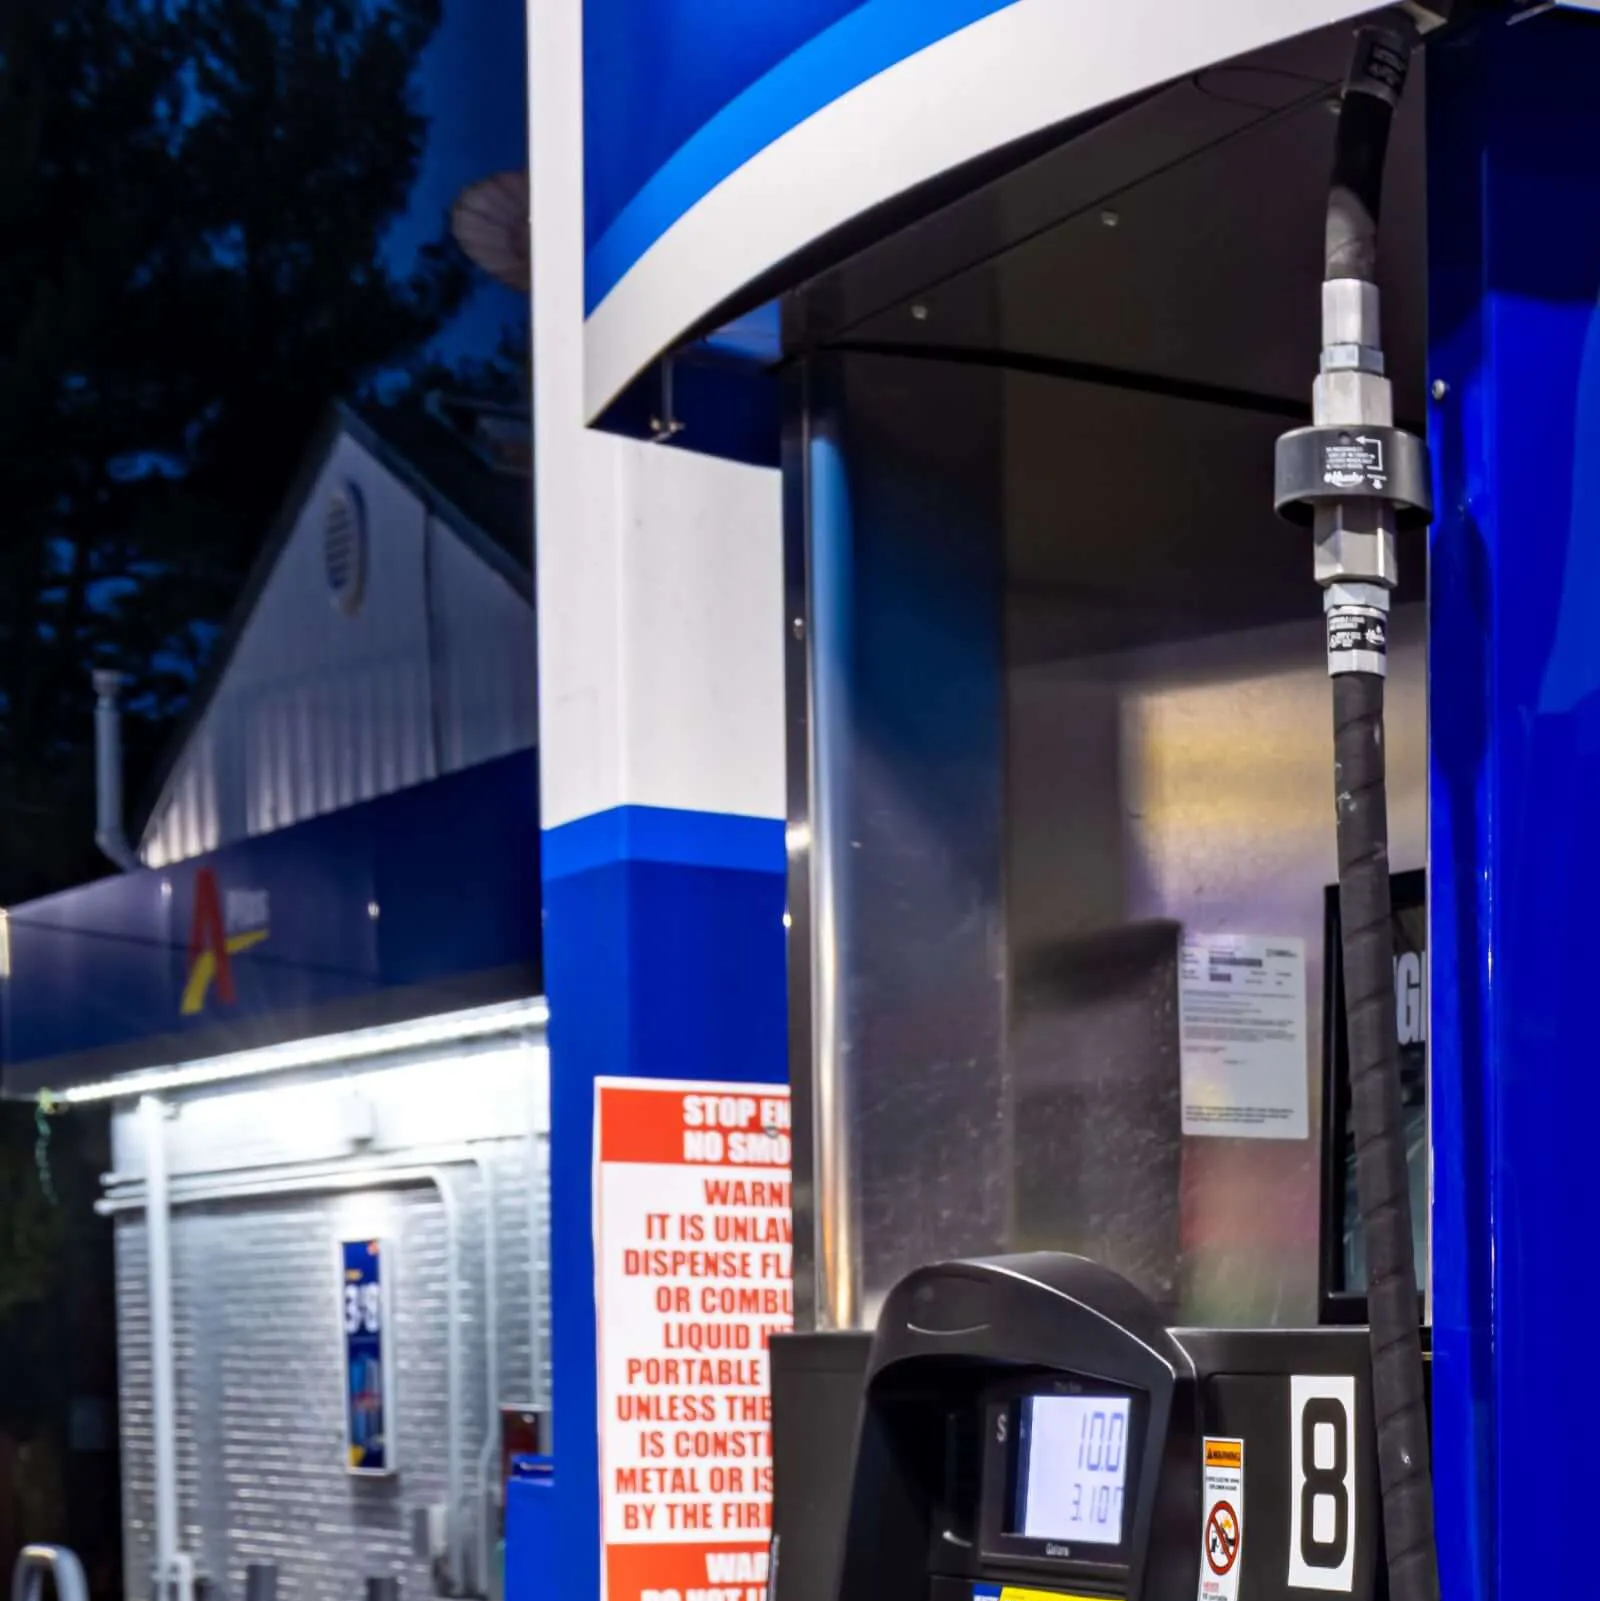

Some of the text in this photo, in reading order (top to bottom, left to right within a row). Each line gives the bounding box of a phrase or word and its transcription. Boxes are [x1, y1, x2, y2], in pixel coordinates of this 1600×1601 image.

[683, 1095, 756, 1127] STOP
[683, 1130, 723, 1162] NO
[646, 1214, 670, 1240] IT
[680, 1215, 704, 1241] IS
[624, 1249, 752, 1277] DISPENSE
[656, 1286, 690, 1313] OR
[664, 1323, 750, 1352] LIQUID
[627, 1358, 760, 1386] PORTABLE
[617, 1395, 715, 1422] UNLESS
[640, 1431, 664, 1458] IS
[616, 1467, 699, 1494] METAL
[709, 1466, 743, 1493] OR
[1301, 1397, 1348, 1569] 8
[624, 1503, 655, 1530] BY
[666, 1503, 713, 1529] THE
